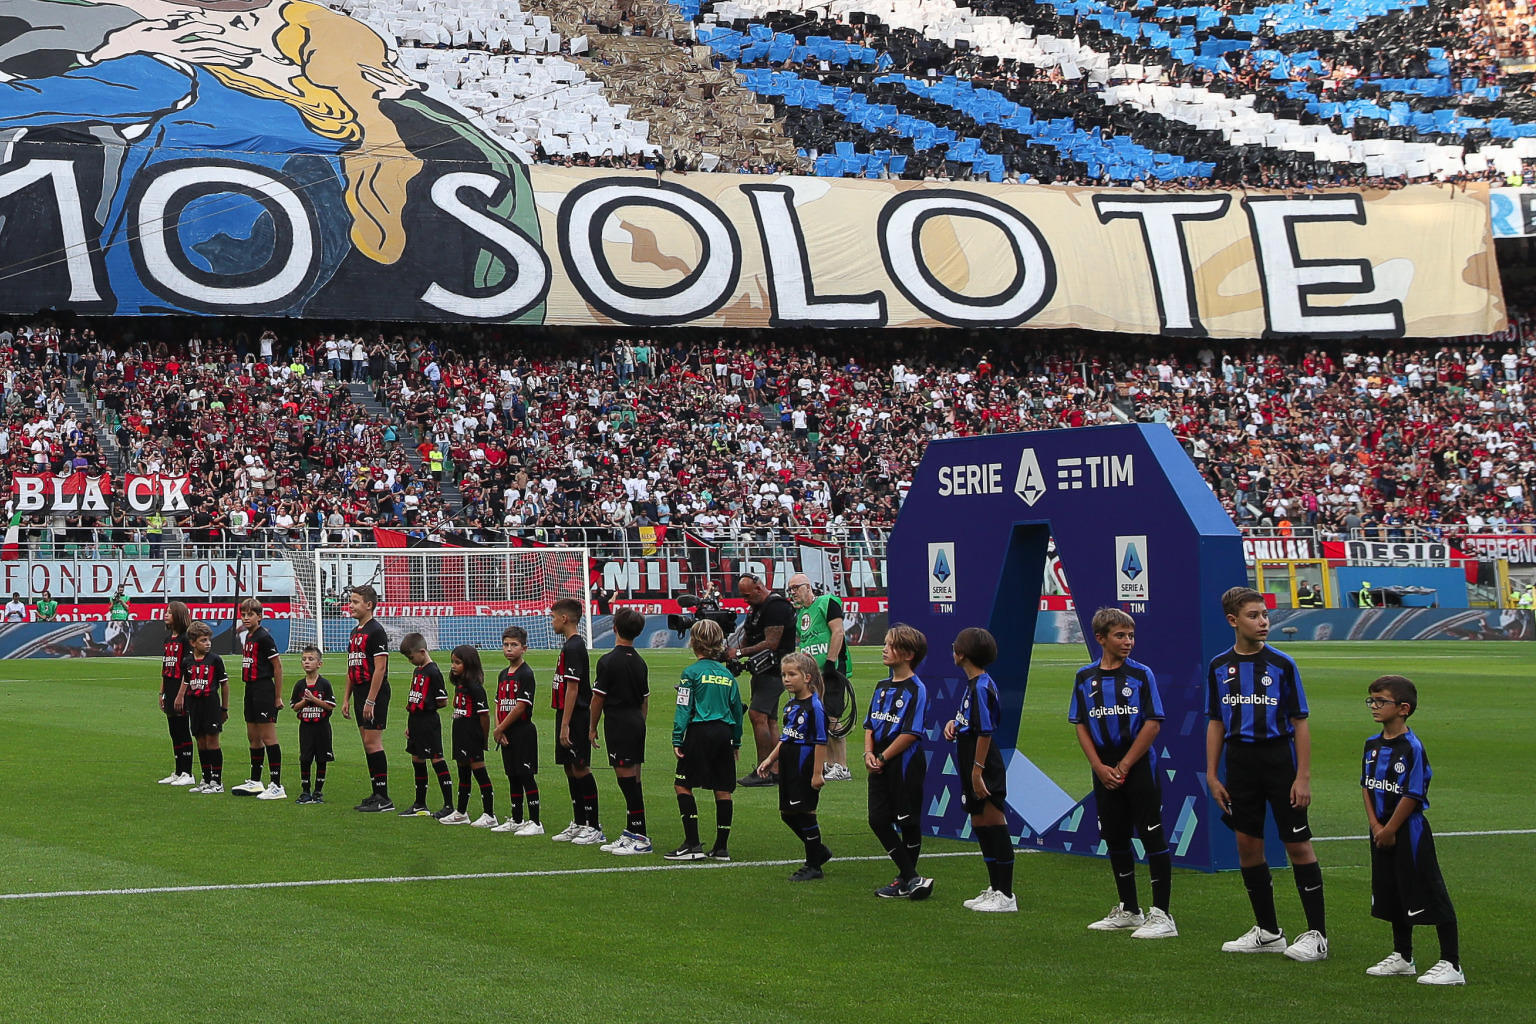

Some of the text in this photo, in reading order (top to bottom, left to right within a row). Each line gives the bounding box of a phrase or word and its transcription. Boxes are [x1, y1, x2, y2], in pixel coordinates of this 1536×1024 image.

[422, 169, 1057, 328] SOLO
[1092, 193, 1405, 338] TE
[938, 463, 1003, 497] SERIE
[1086, 454, 1134, 488] TIM
[5, 563, 273, 594] FONDAZIONE
[933, 586, 947, 594] SERIE
[1121, 584, 1139, 592] SERIE
[940, 603, 953, 613] TIM
[1129, 603, 1145, 613] TIM
[1222, 692, 1278, 707] digitalbits
[1088, 704, 1139, 719] digitalbits
